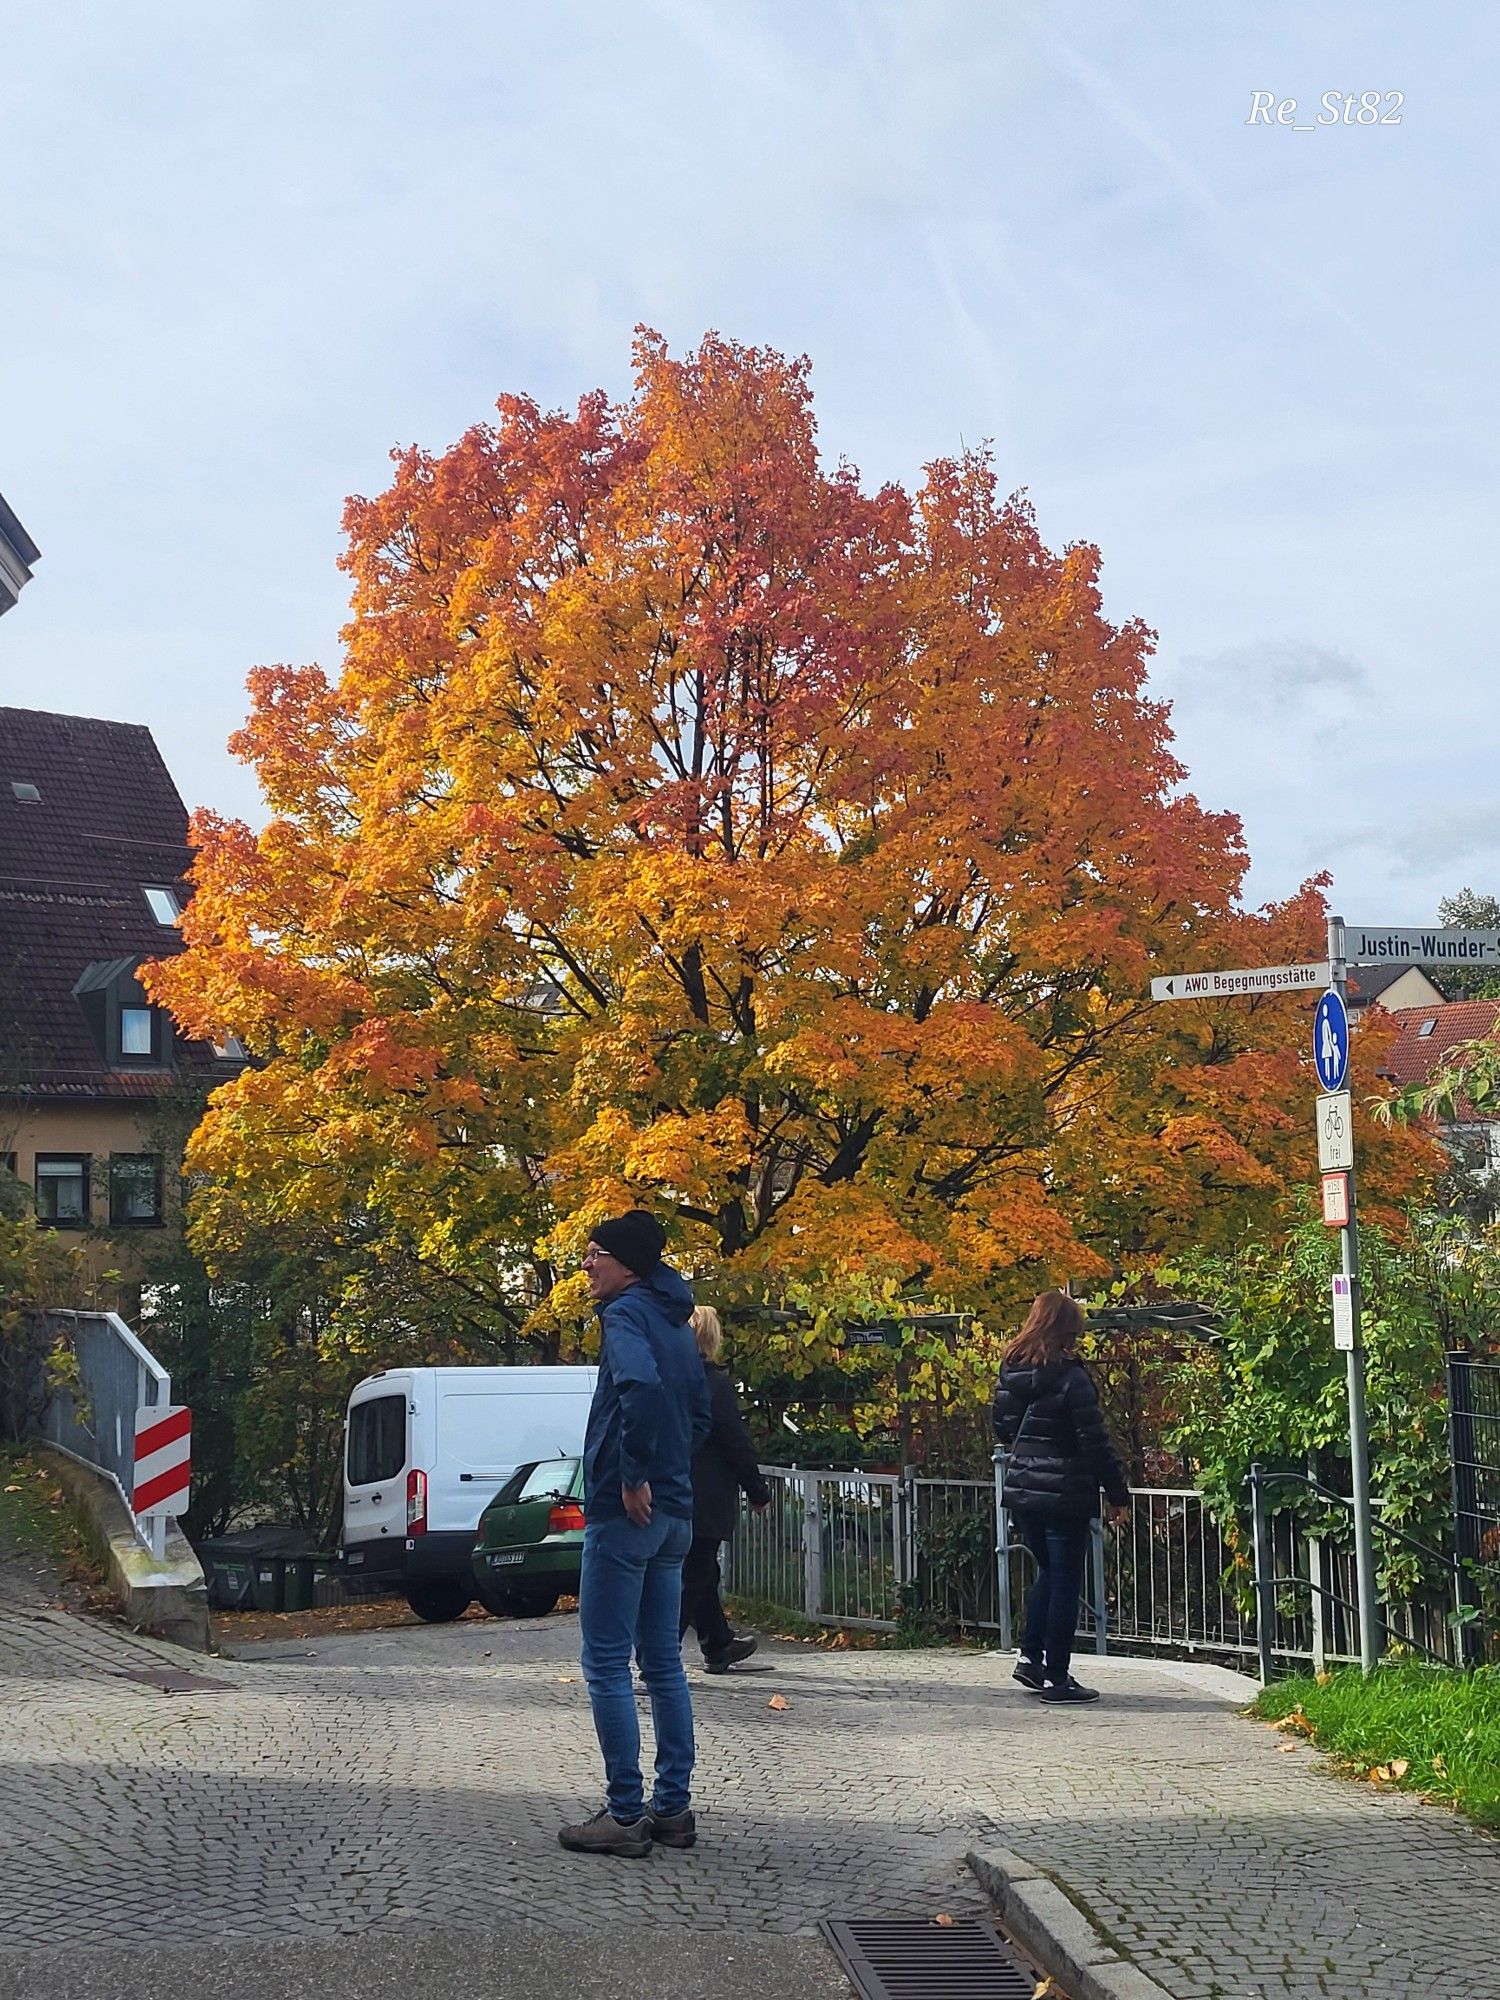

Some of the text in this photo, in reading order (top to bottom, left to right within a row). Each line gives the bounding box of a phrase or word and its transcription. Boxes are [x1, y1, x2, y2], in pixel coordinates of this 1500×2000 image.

[1185, 968, 1316, 993] AWO Begegnungsstätte
[1329, 1143, 1341, 1161] frei
